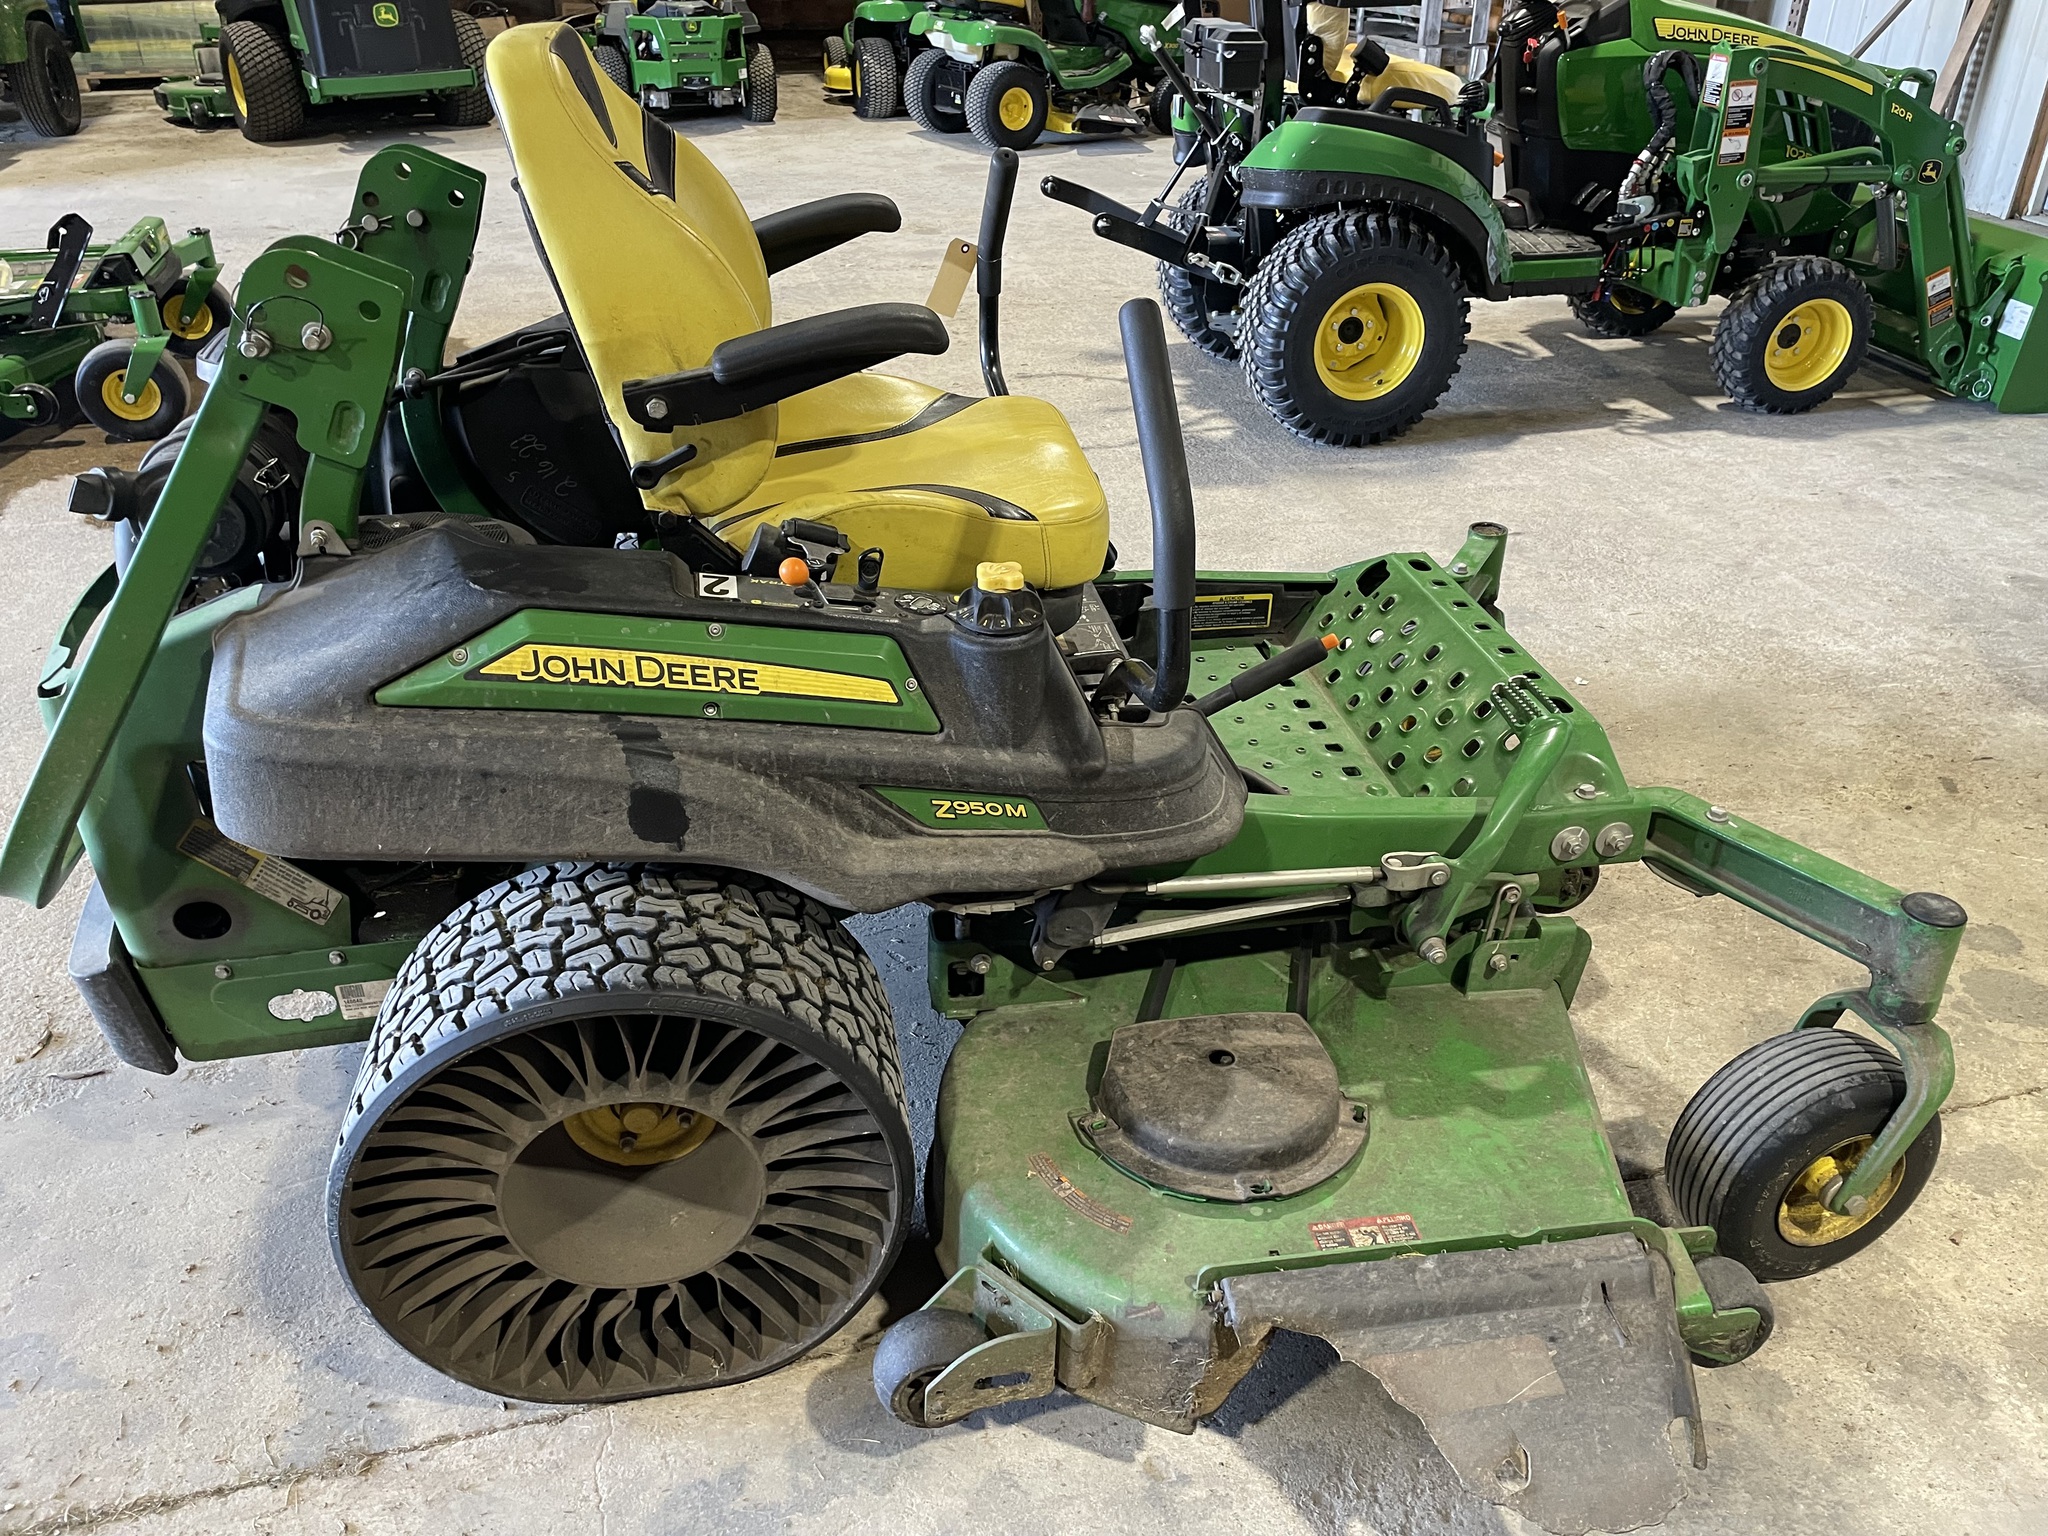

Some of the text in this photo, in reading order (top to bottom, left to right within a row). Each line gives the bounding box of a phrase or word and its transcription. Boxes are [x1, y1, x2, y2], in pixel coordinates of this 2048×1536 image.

[1667, 24, 1759, 46] JOHN DEERE
[521, 650, 759, 690] JOHN DEERE
[931, 799, 1027, 819] Z950M
